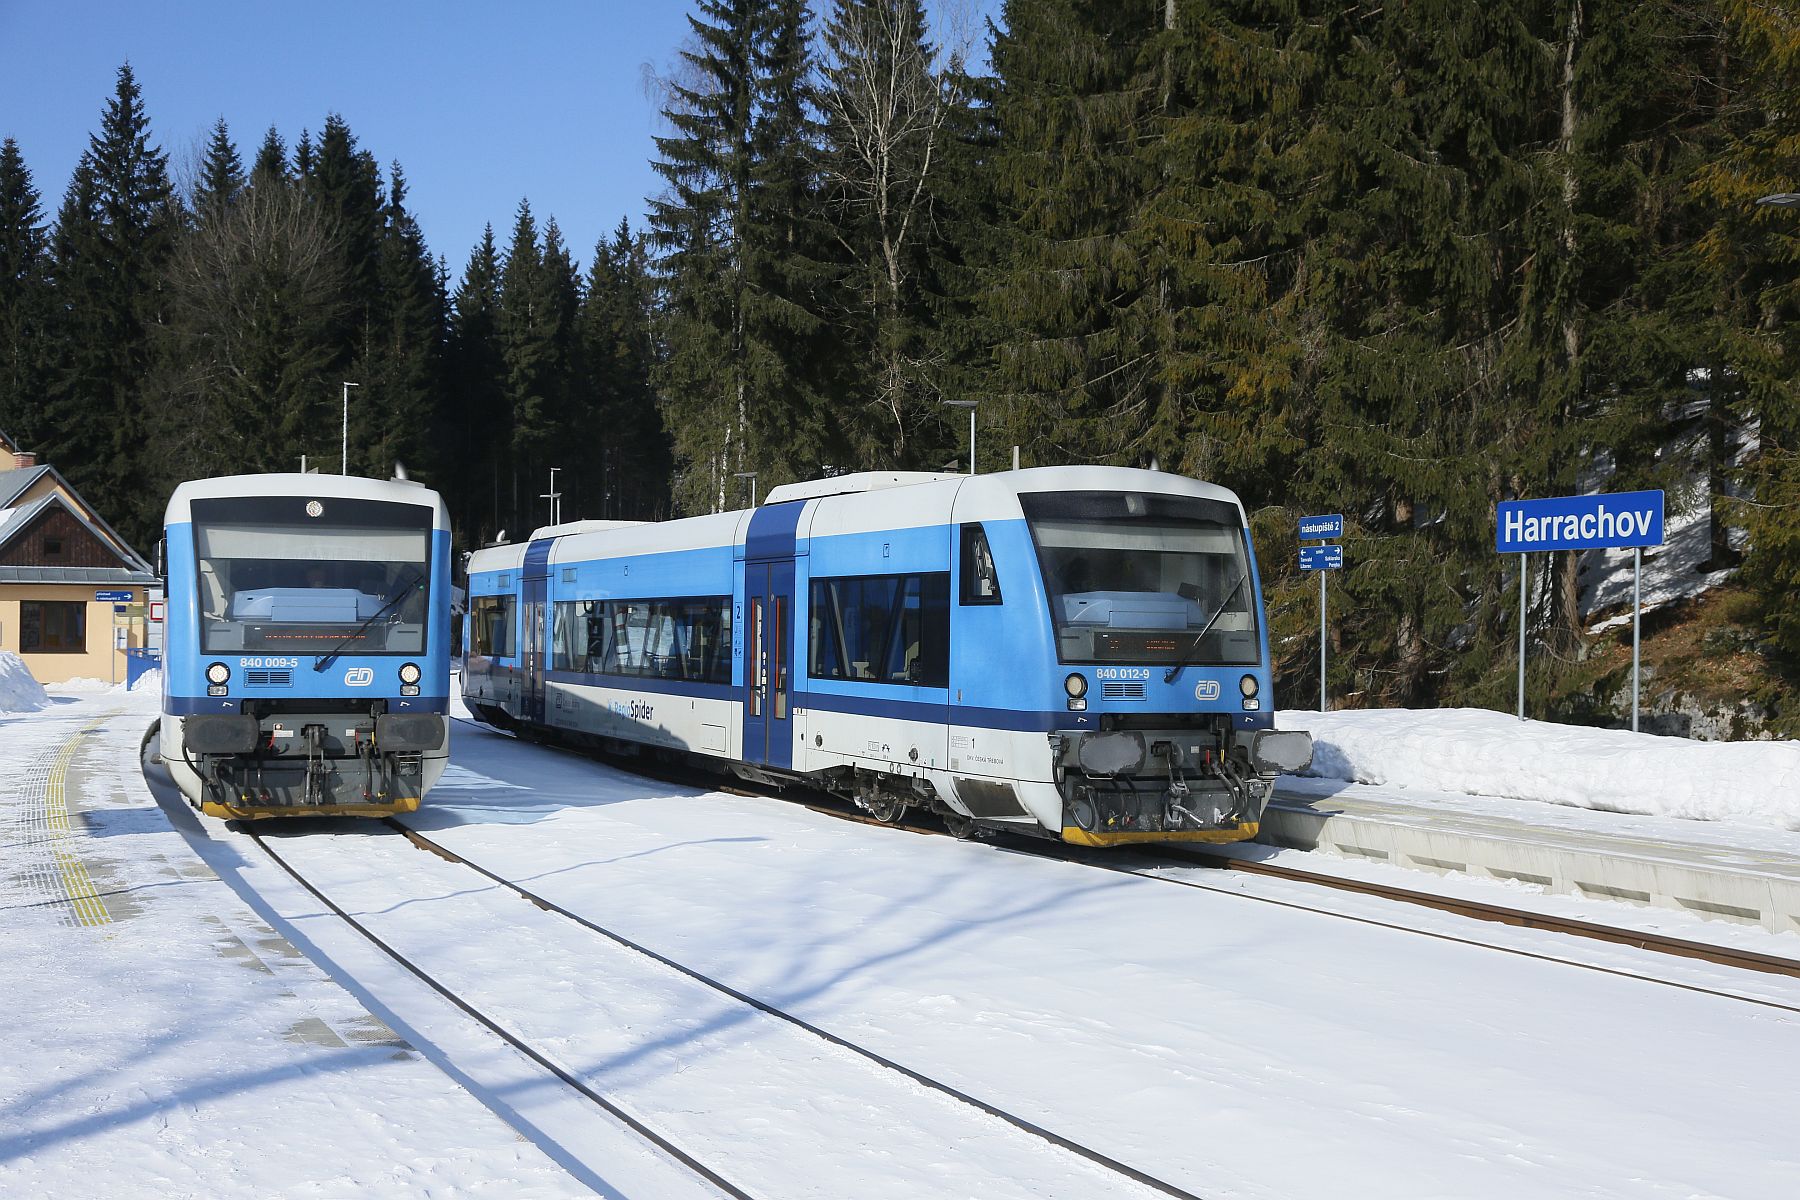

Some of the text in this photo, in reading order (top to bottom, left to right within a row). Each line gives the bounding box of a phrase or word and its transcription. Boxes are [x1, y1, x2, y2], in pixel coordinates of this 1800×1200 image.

[1302, 522, 1339, 534] nástupiště 2
[1505, 505, 1653, 542] Harrachov
[736, 606, 740, 619] 2
[240, 657, 298, 668] 840 009-5
[1096, 668, 1150, 679] 840 012-9
[972, 738, 975, 749] 1
